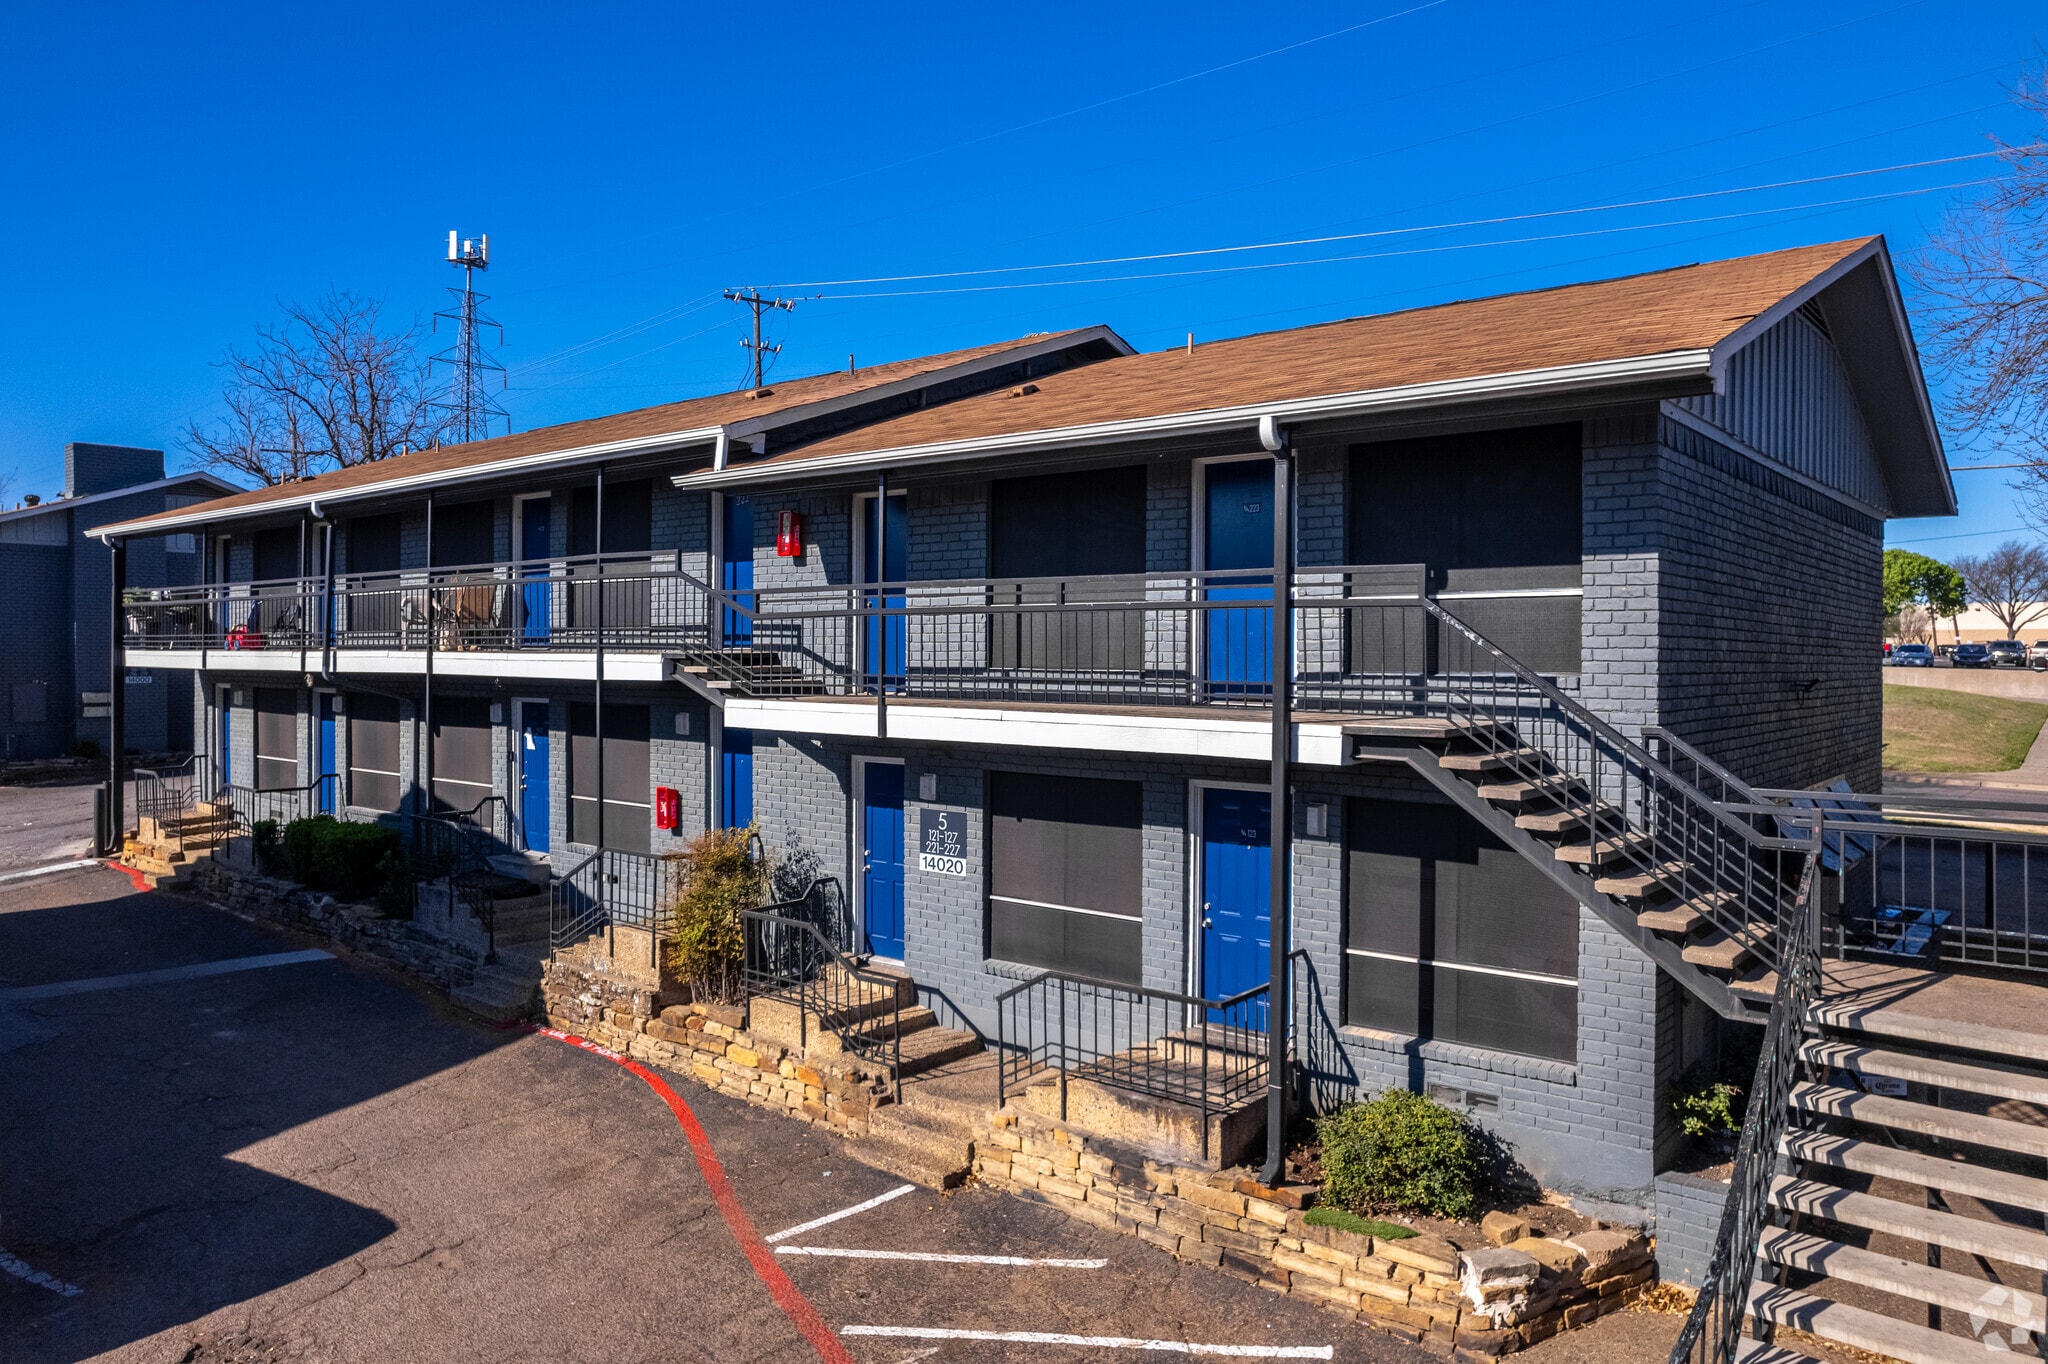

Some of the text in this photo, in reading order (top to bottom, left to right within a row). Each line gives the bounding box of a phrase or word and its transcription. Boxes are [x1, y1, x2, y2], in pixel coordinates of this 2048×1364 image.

[938, 812, 948, 830] 5
[928, 829, 958, 843] 121-127
[926, 841, 960, 856] 221-227
[922, 856, 963, 874] 14020
[1875, 1081, 1901, 1090] Corona
